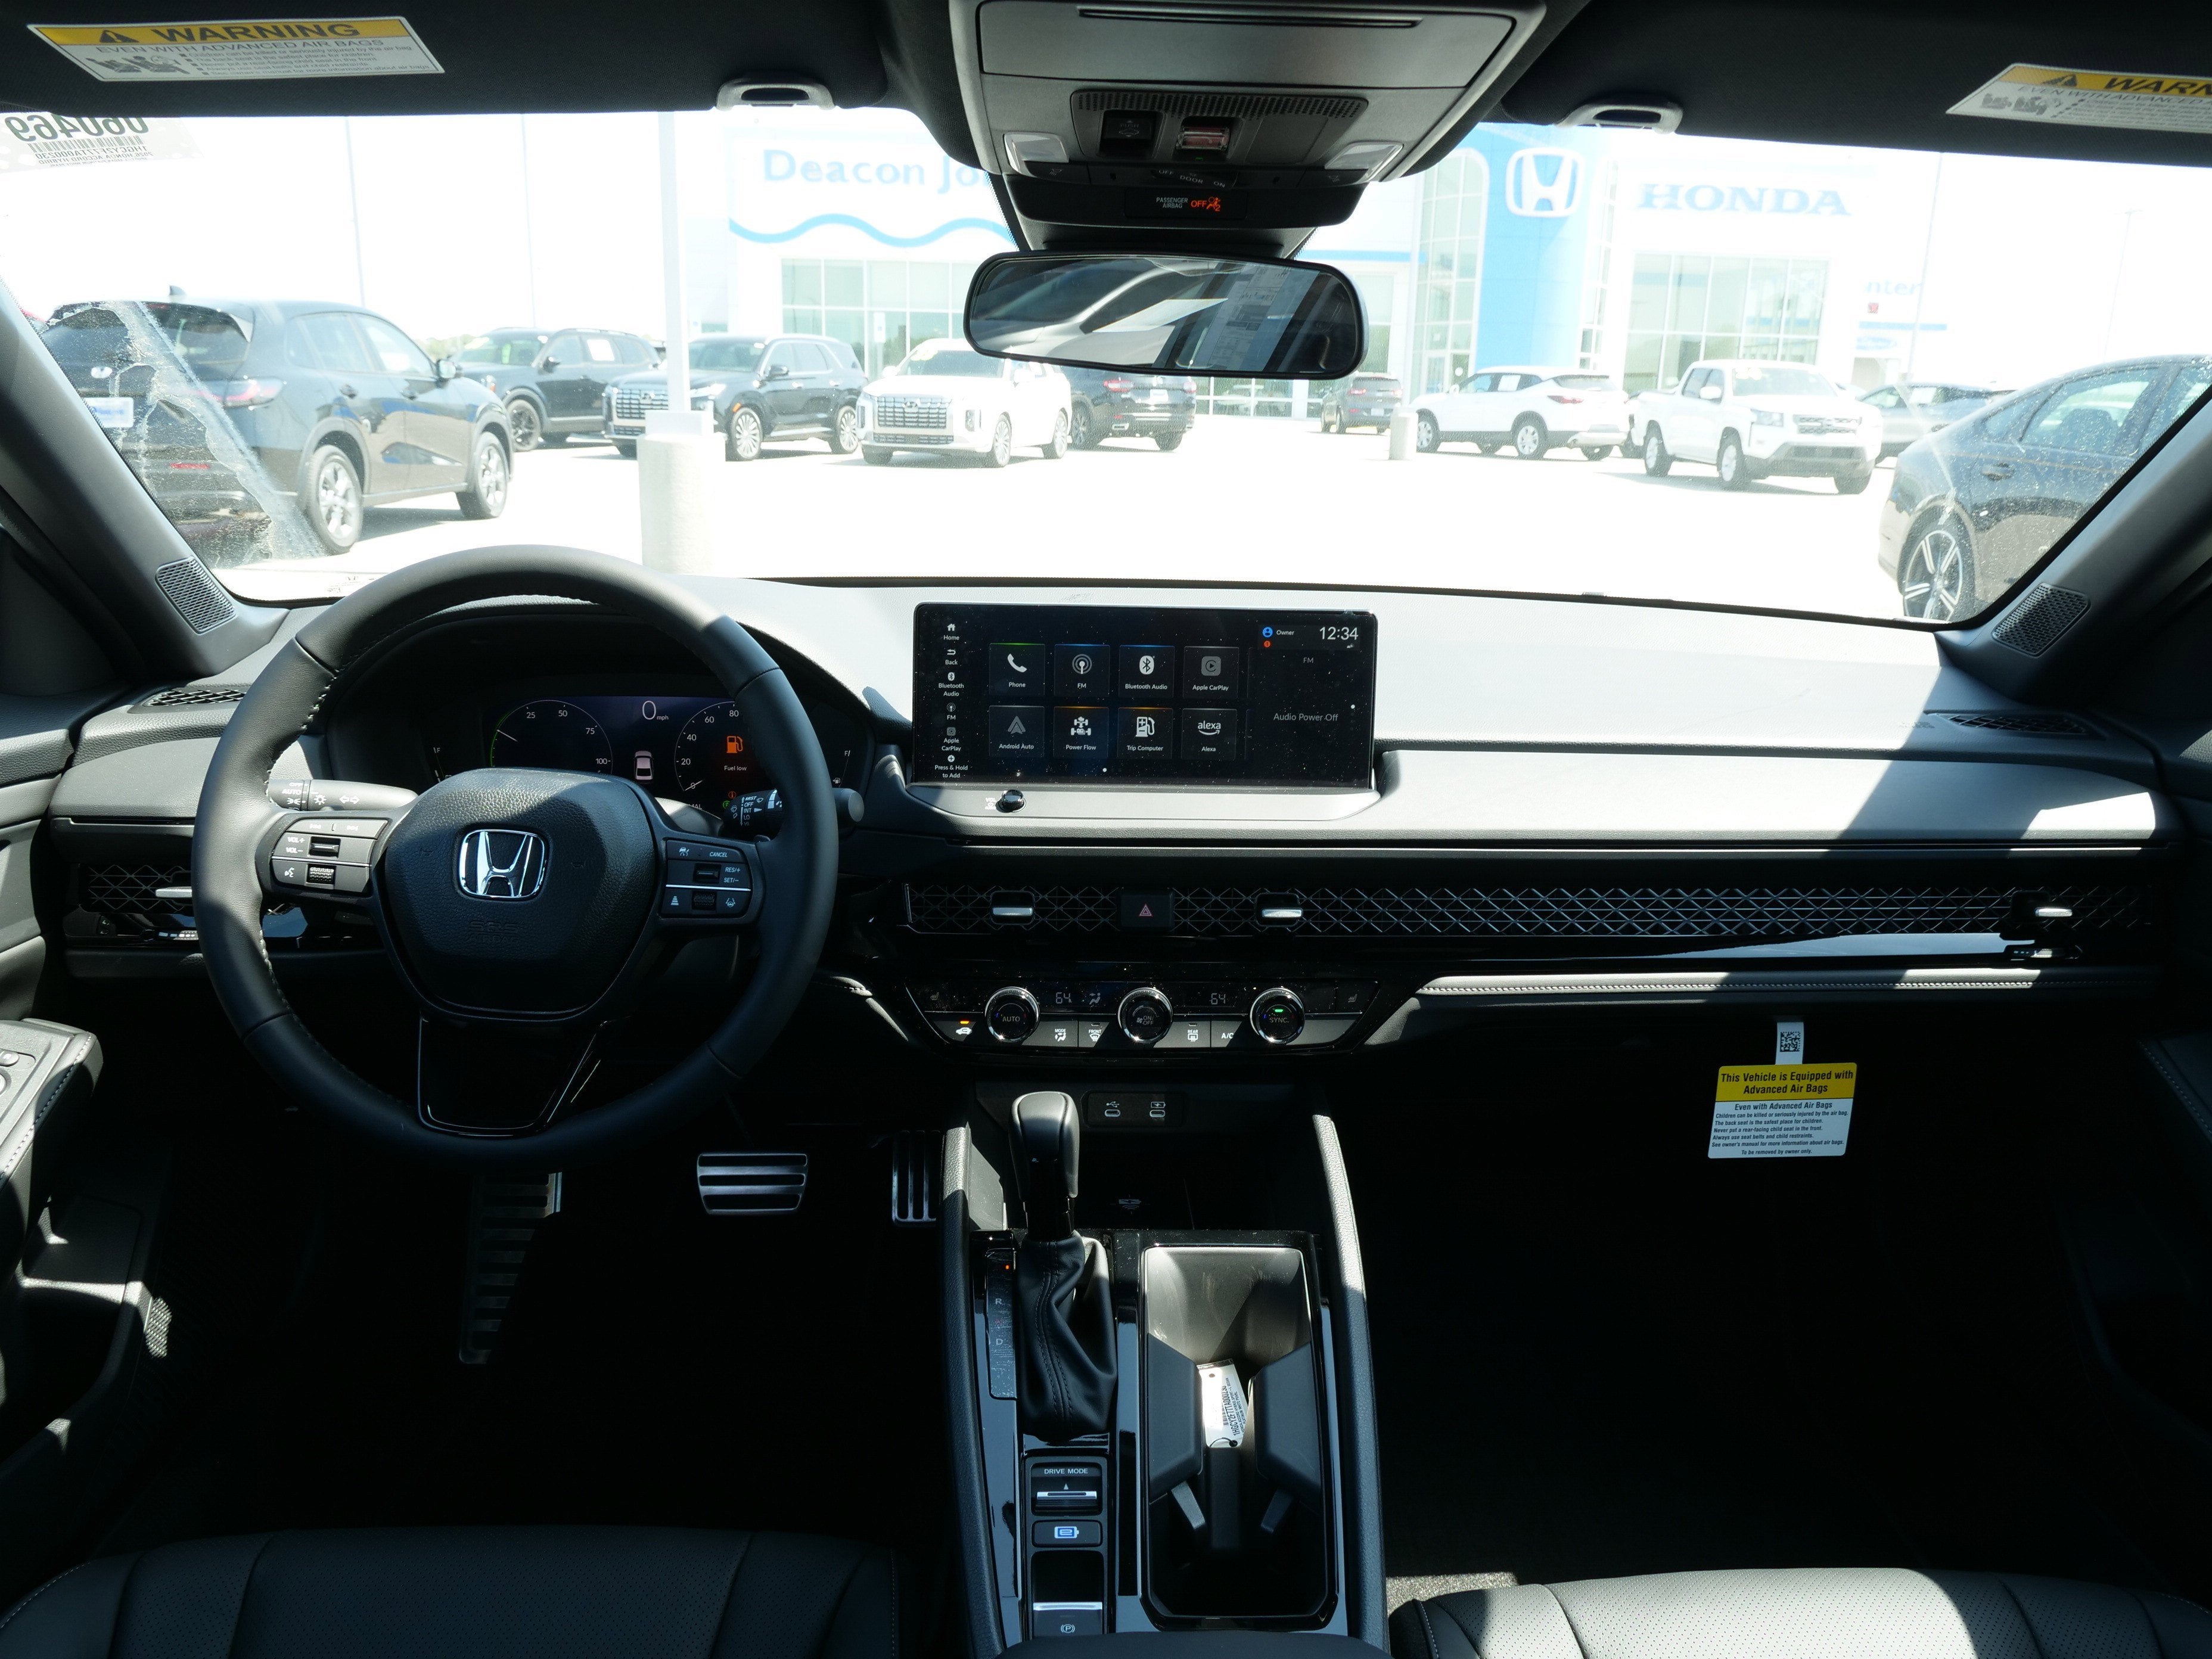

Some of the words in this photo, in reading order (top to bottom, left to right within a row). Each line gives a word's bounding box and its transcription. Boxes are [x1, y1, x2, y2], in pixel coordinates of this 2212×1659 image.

[151, 24, 360, 42] WARNING
[202, 42, 297, 51] ADVANCED
[2018, 86, 2064, 95] EVEN
[2068, 90, 2114, 99] WITH
[763, 148, 925, 185] Deacon
[1180, 175, 1204, 184] DOOR
[1638, 182, 1851, 216] HONDA
[1319, 626, 1359, 641] 12:34
[642, 700, 657, 720] 0
[704, 716, 714, 724] 60
[1273, 713, 1297, 721] Audio
[1298, 713, 1324, 721] Power
[1197, 720, 1222, 730] alexa
[1055, 992, 1072, 1005] 64
[1210, 993, 1226, 1005] 64
[1722, 1073, 1739, 1082] This
[1744, 1073, 1776, 1082] Vehicle
[1779, 1072, 1787, 1080] is
[1790, 1071, 1832, 1082] Equipped
[1835, 1070, 1853, 1079] with
[1744, 1085, 1787, 1094] Advanced
[1790, 1084, 1803, 1092] Air
[1806, 1084, 1828, 1093] Bags
